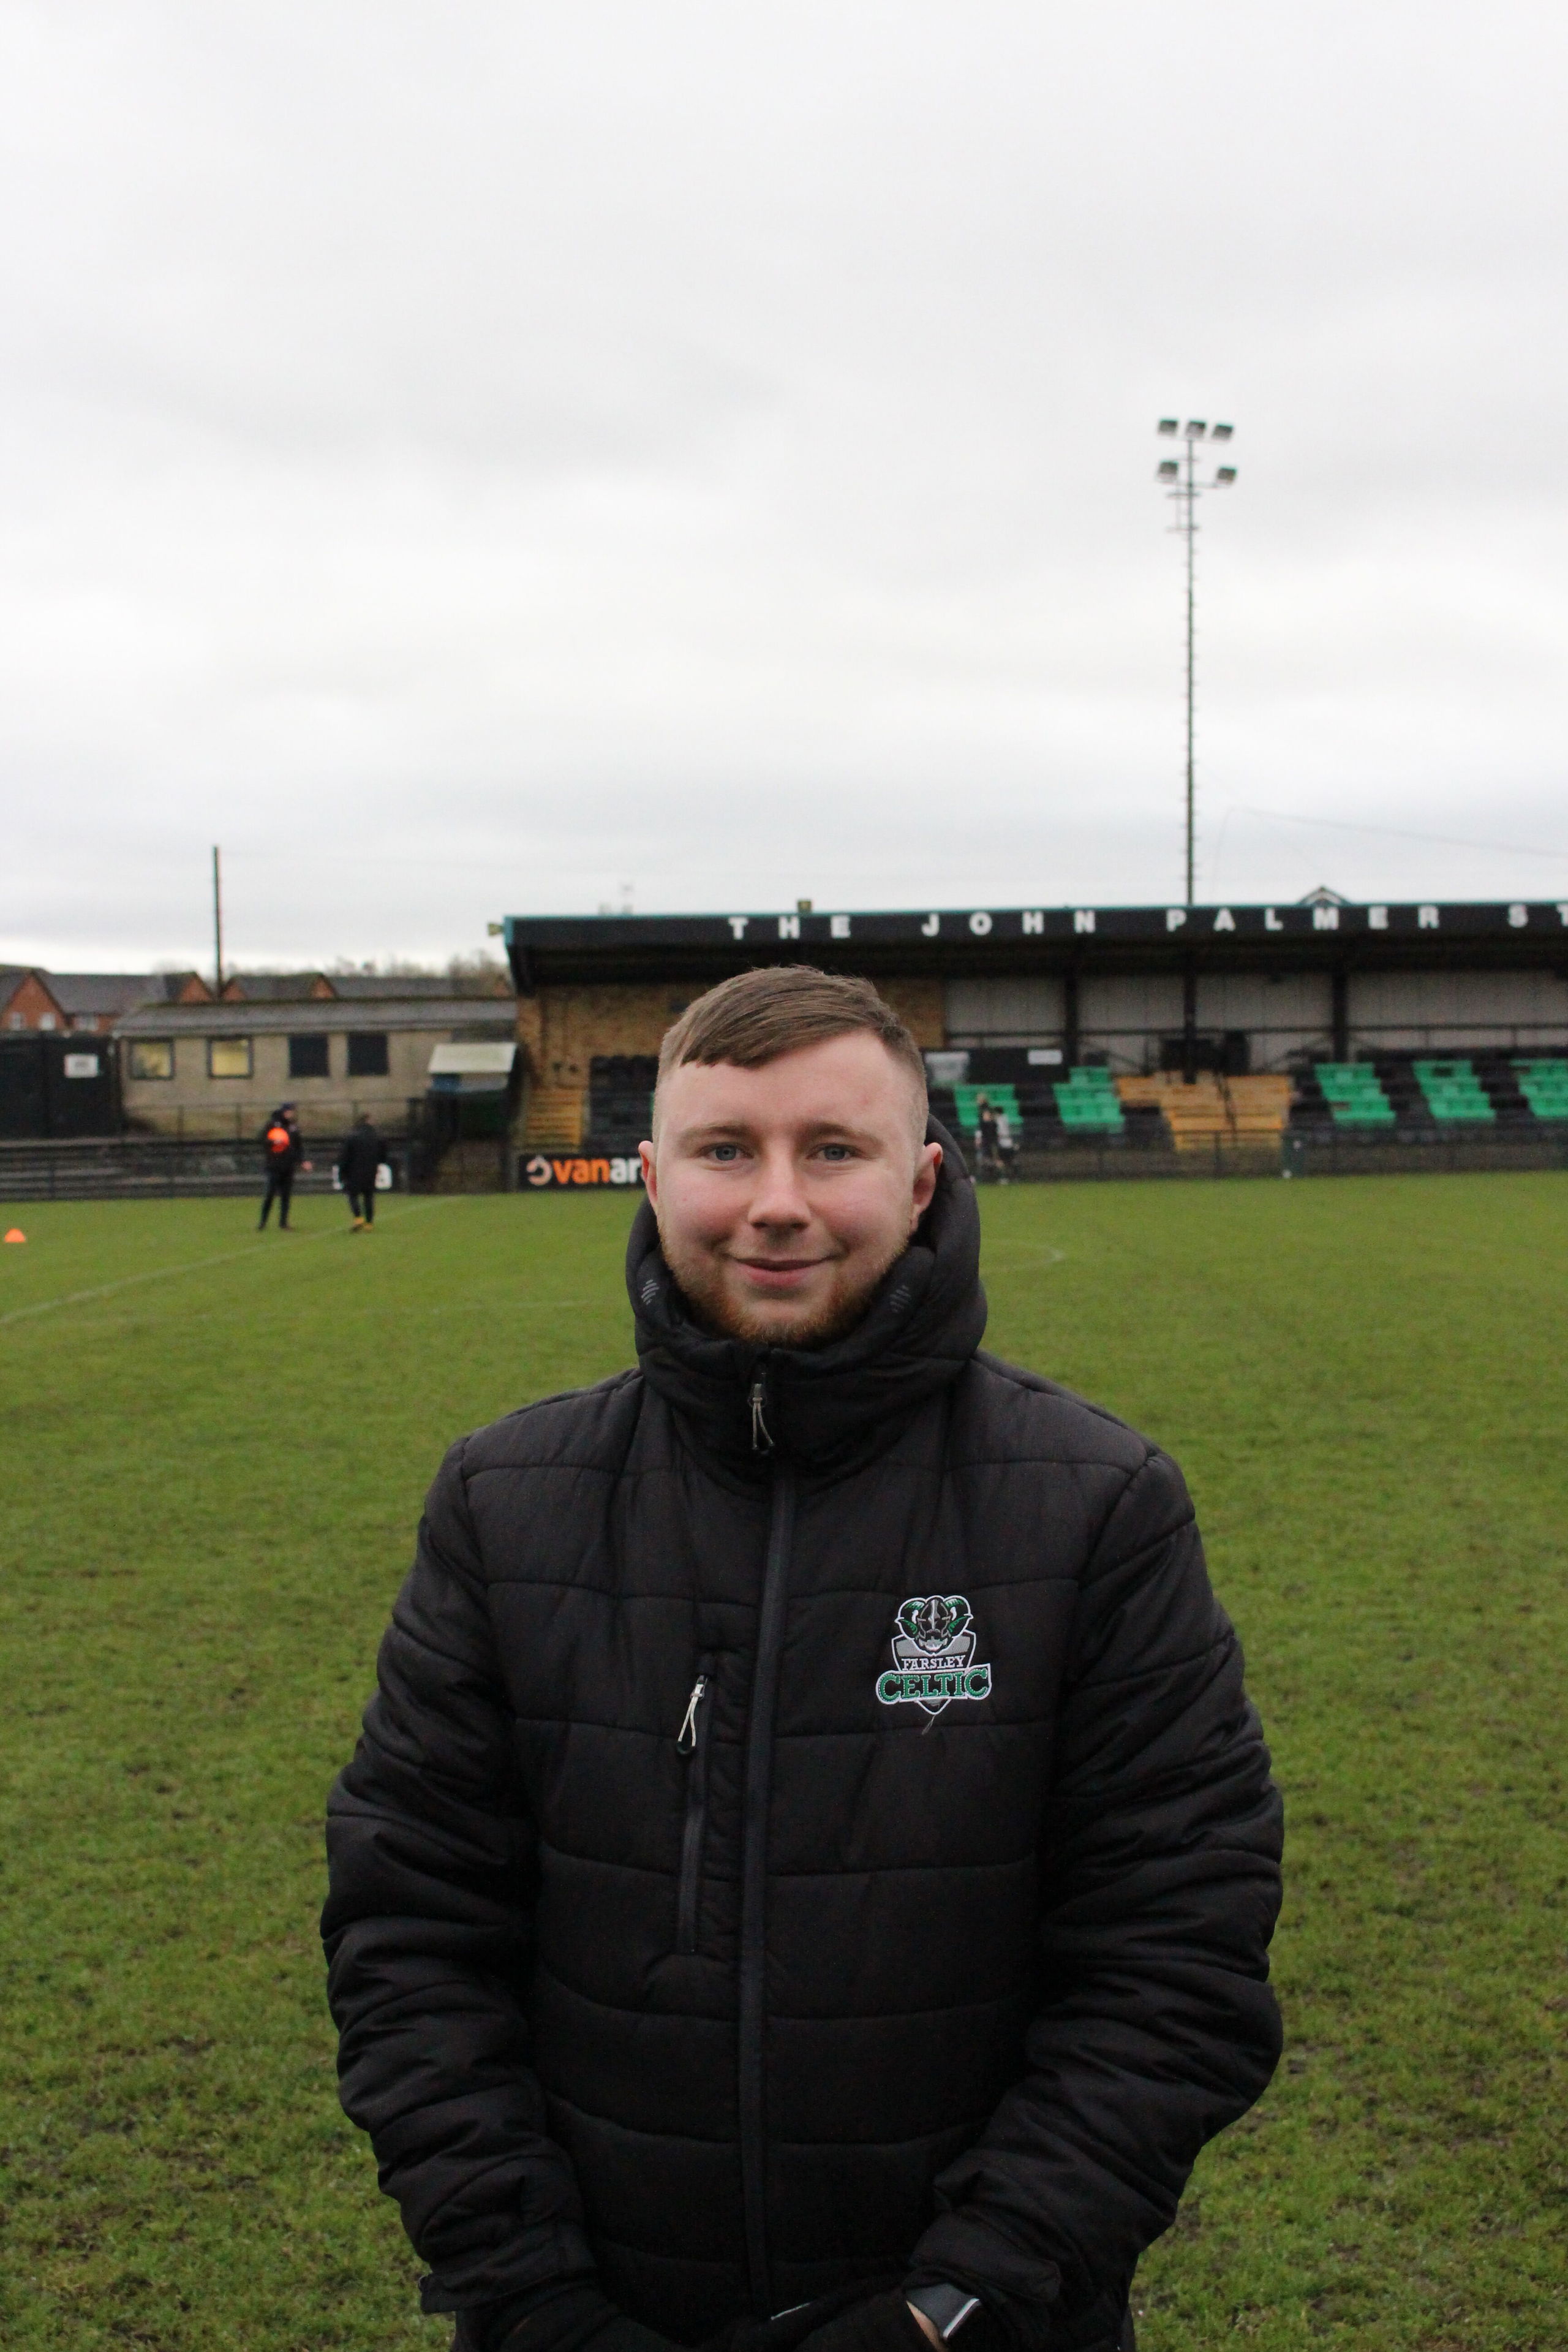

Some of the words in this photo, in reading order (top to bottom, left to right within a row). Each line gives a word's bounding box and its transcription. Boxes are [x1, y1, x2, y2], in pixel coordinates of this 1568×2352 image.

[728, 915, 851, 939] THE
[922, 911, 1097, 937] JOHN
[1166, 906, 1439, 931] PALMER
[552, 1158, 644, 1184] vanar
[902, 1655, 965, 1671] FARSLEY
[878, 1668, 989, 1701] CELTIC
